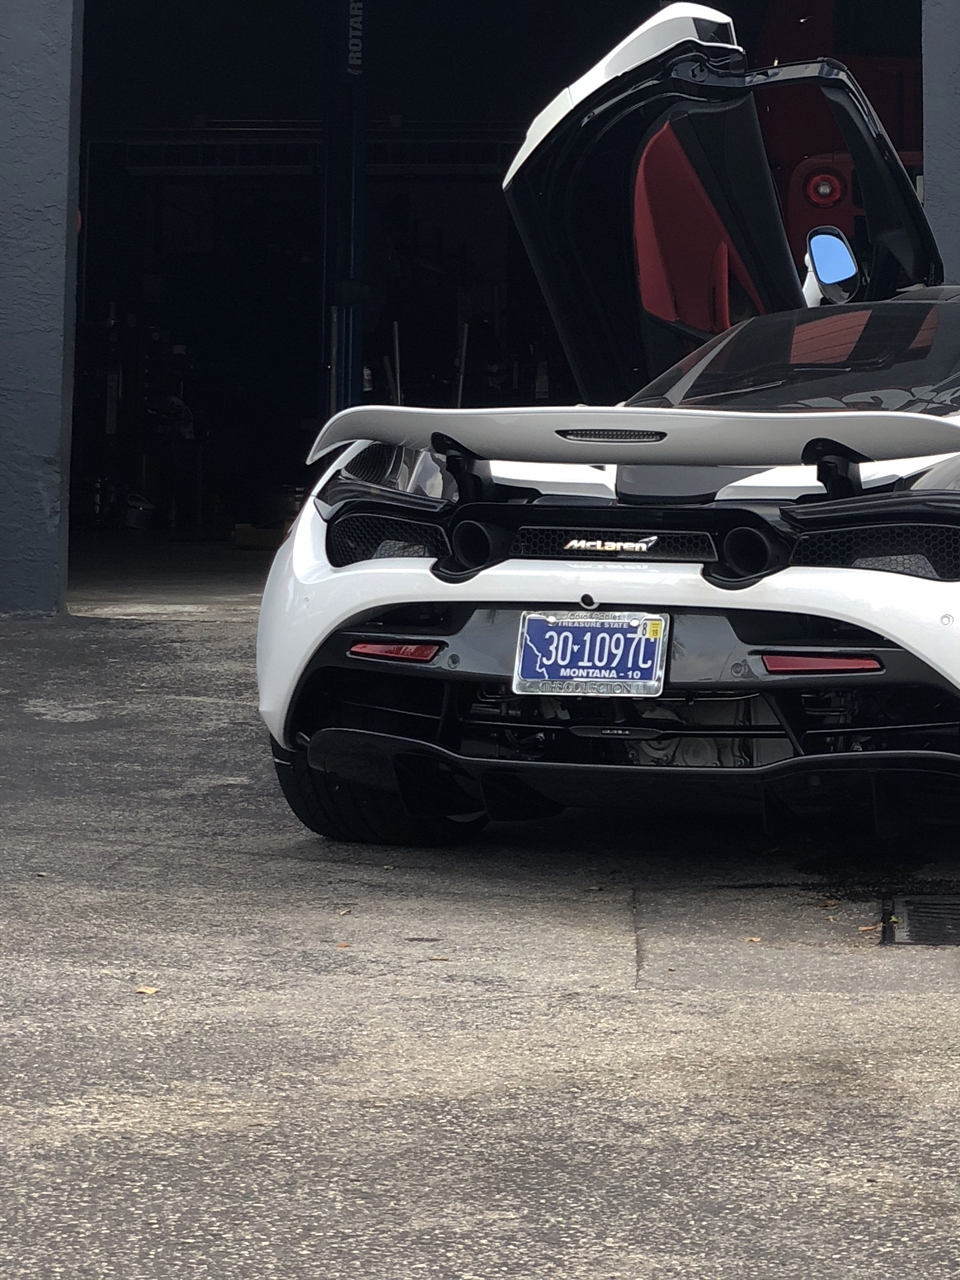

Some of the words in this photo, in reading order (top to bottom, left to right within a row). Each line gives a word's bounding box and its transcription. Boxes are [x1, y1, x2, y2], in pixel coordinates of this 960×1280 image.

[563, 539, 647, 552] McLaren
[560, 668, 618, 678] MONTANA
[628, 671, 641, 679] 10
